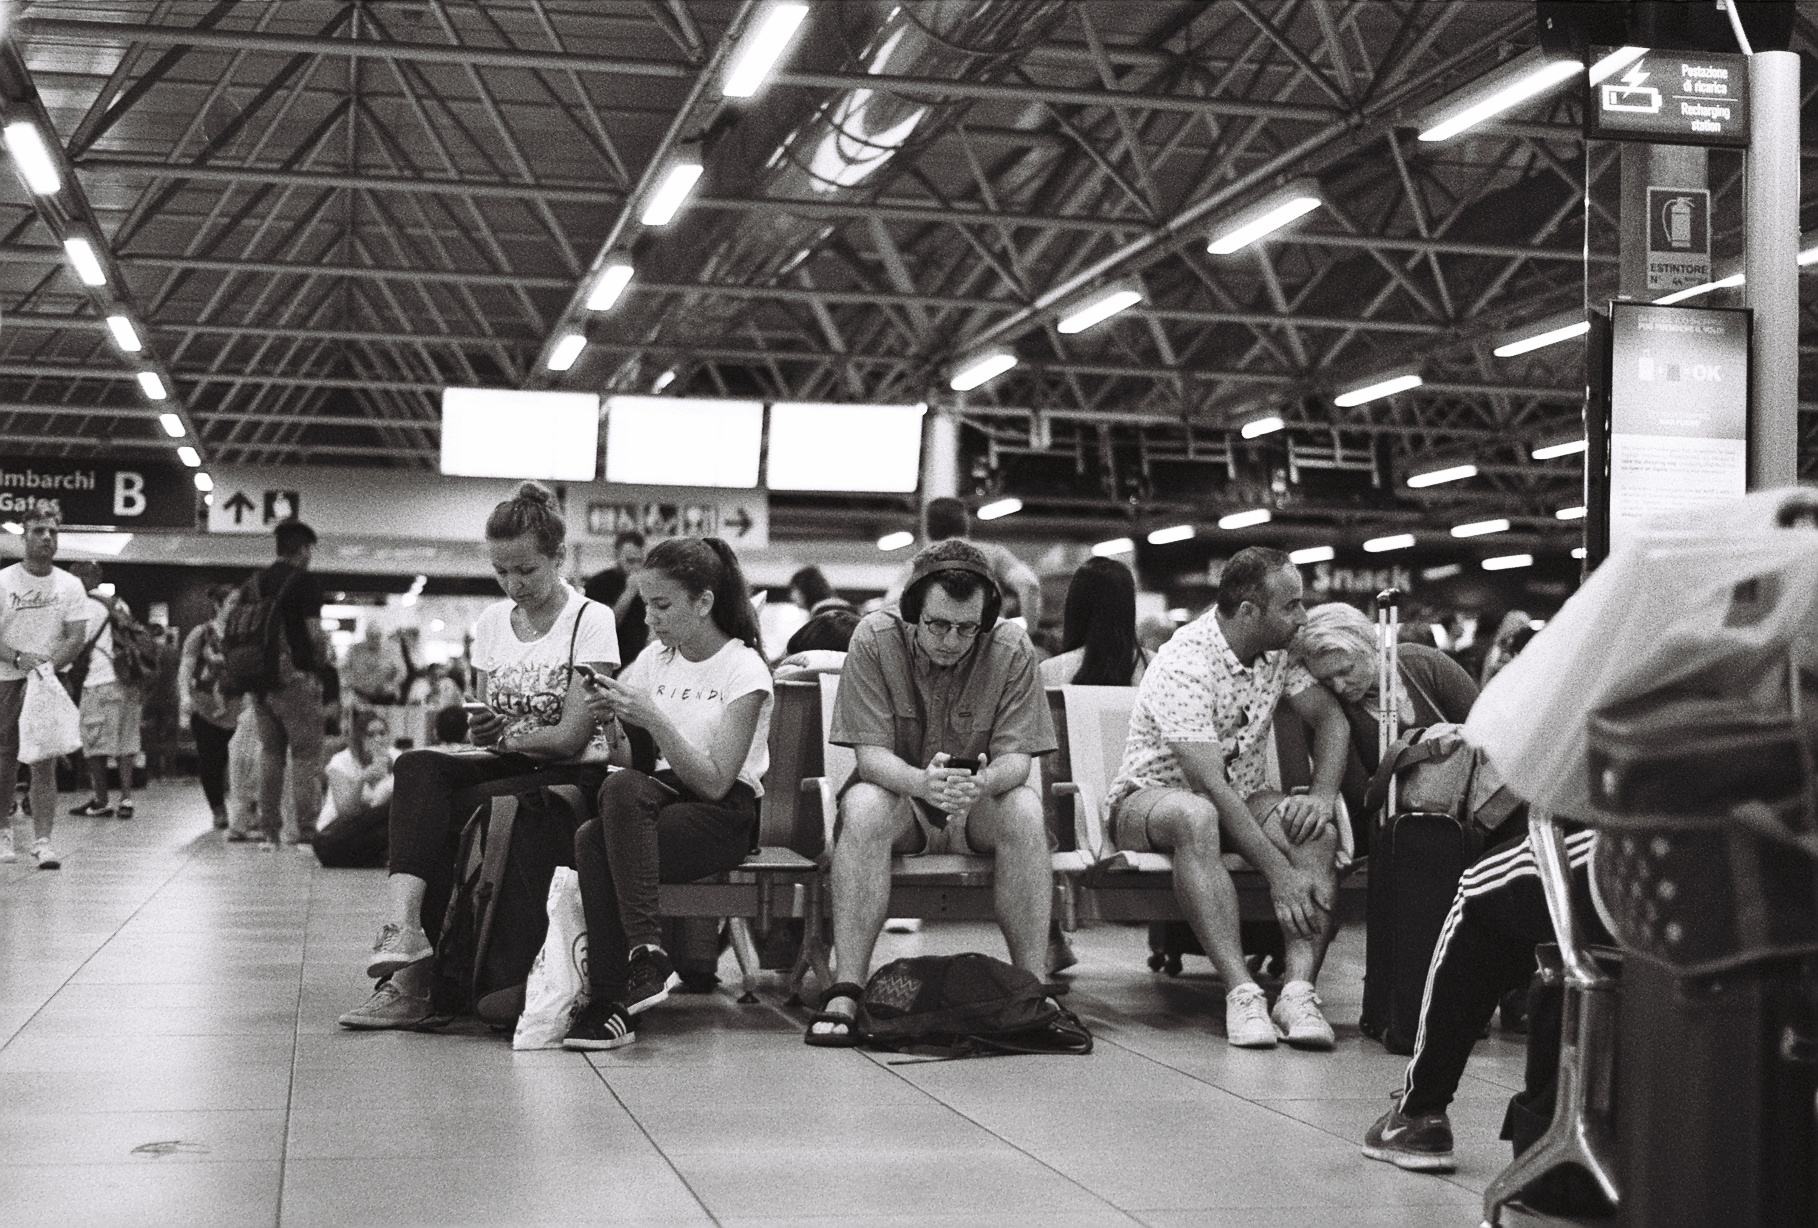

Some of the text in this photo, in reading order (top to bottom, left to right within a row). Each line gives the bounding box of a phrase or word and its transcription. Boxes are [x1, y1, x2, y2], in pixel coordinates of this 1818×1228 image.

[1681, 101, 1730, 119] Recharging
[1691, 119, 1721, 132] station
[1650, 263, 1708, 274] ESTINTORE
[1692, 363, 1722, 383] OK
[113, 471, 147, 516] B
